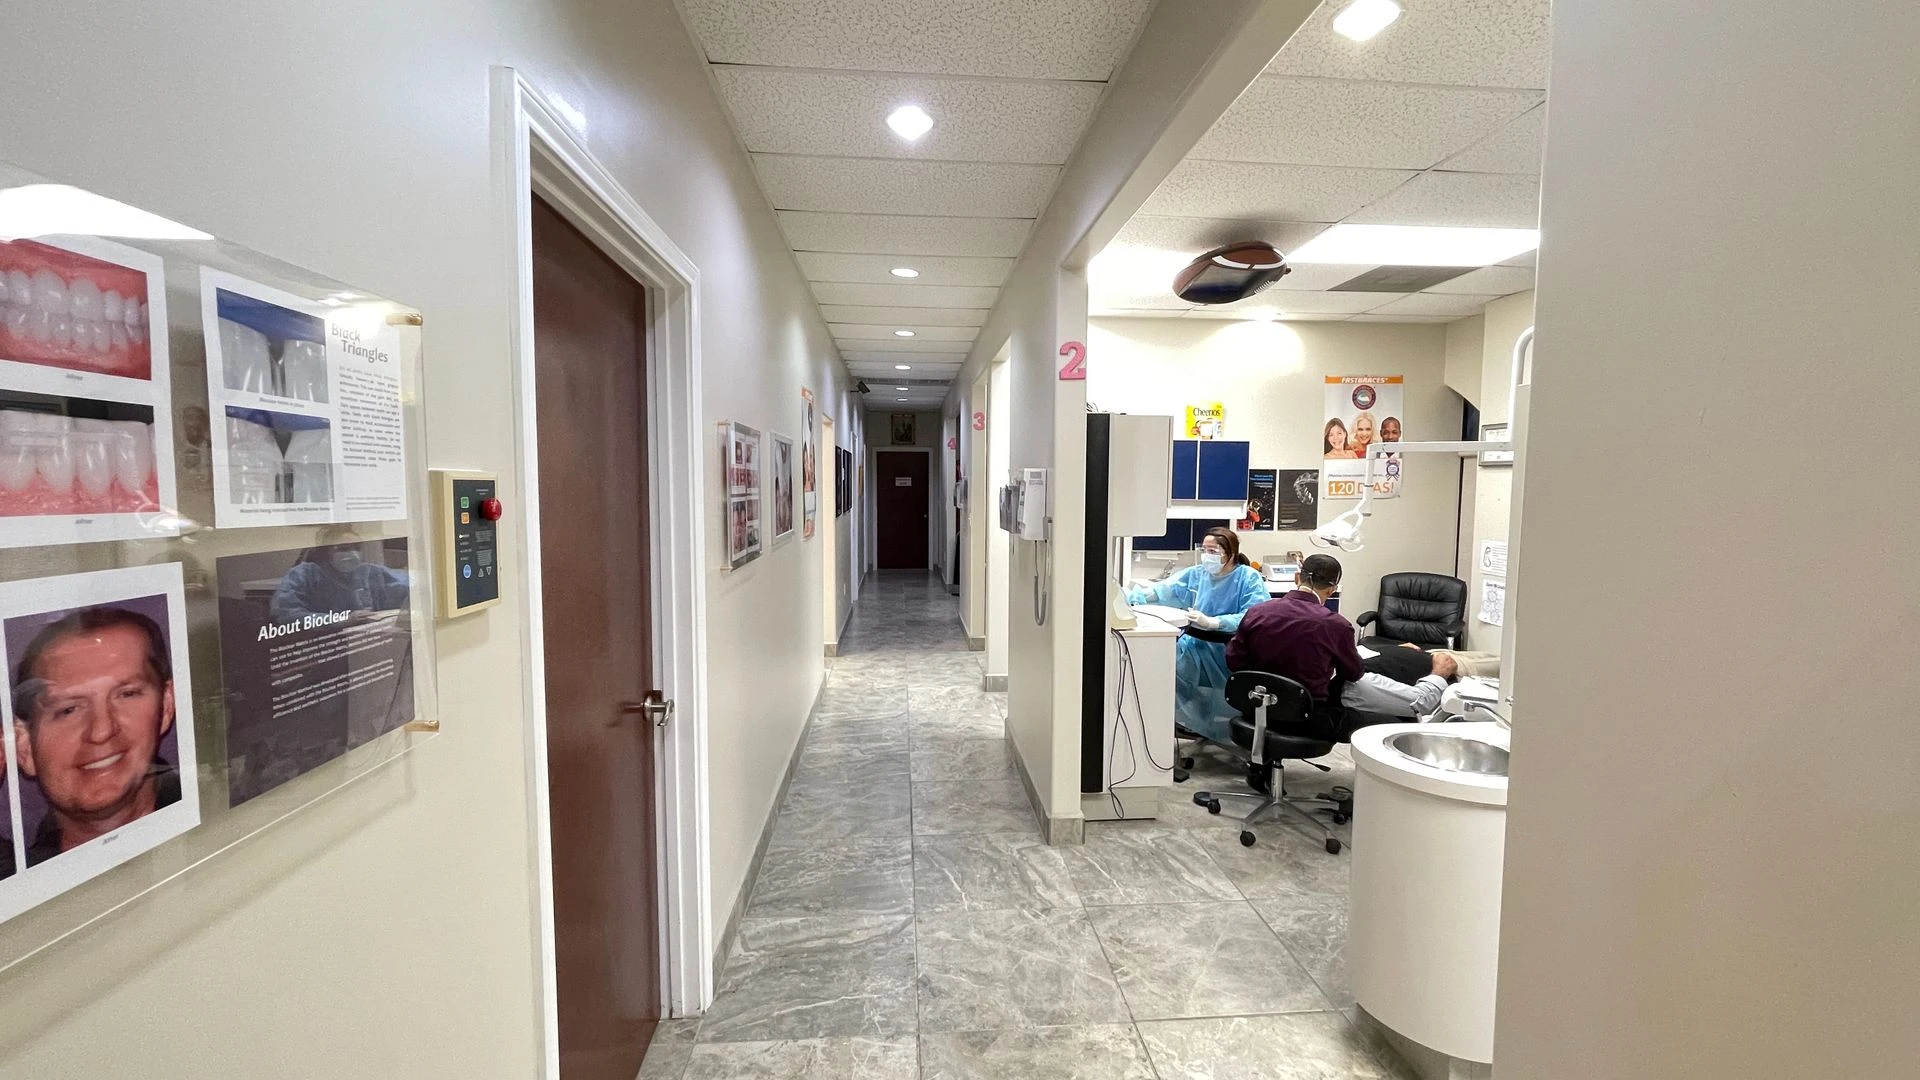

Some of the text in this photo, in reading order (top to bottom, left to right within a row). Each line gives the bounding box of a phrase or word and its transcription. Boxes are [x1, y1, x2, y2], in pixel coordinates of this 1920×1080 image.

[331, 323, 361, 342] Black
[341, 339, 388, 363] Triangles
[1059, 341, 1086, 380] 2
[1193, 407, 1220, 416] Cheerios
[973, 412, 985, 431] 3
[947, 437, 956, 450] 4
[1330, 482, 1394, 495] 120 DAS!
[257, 623, 301, 642] About
[303, 609, 351, 630] Bioclear
